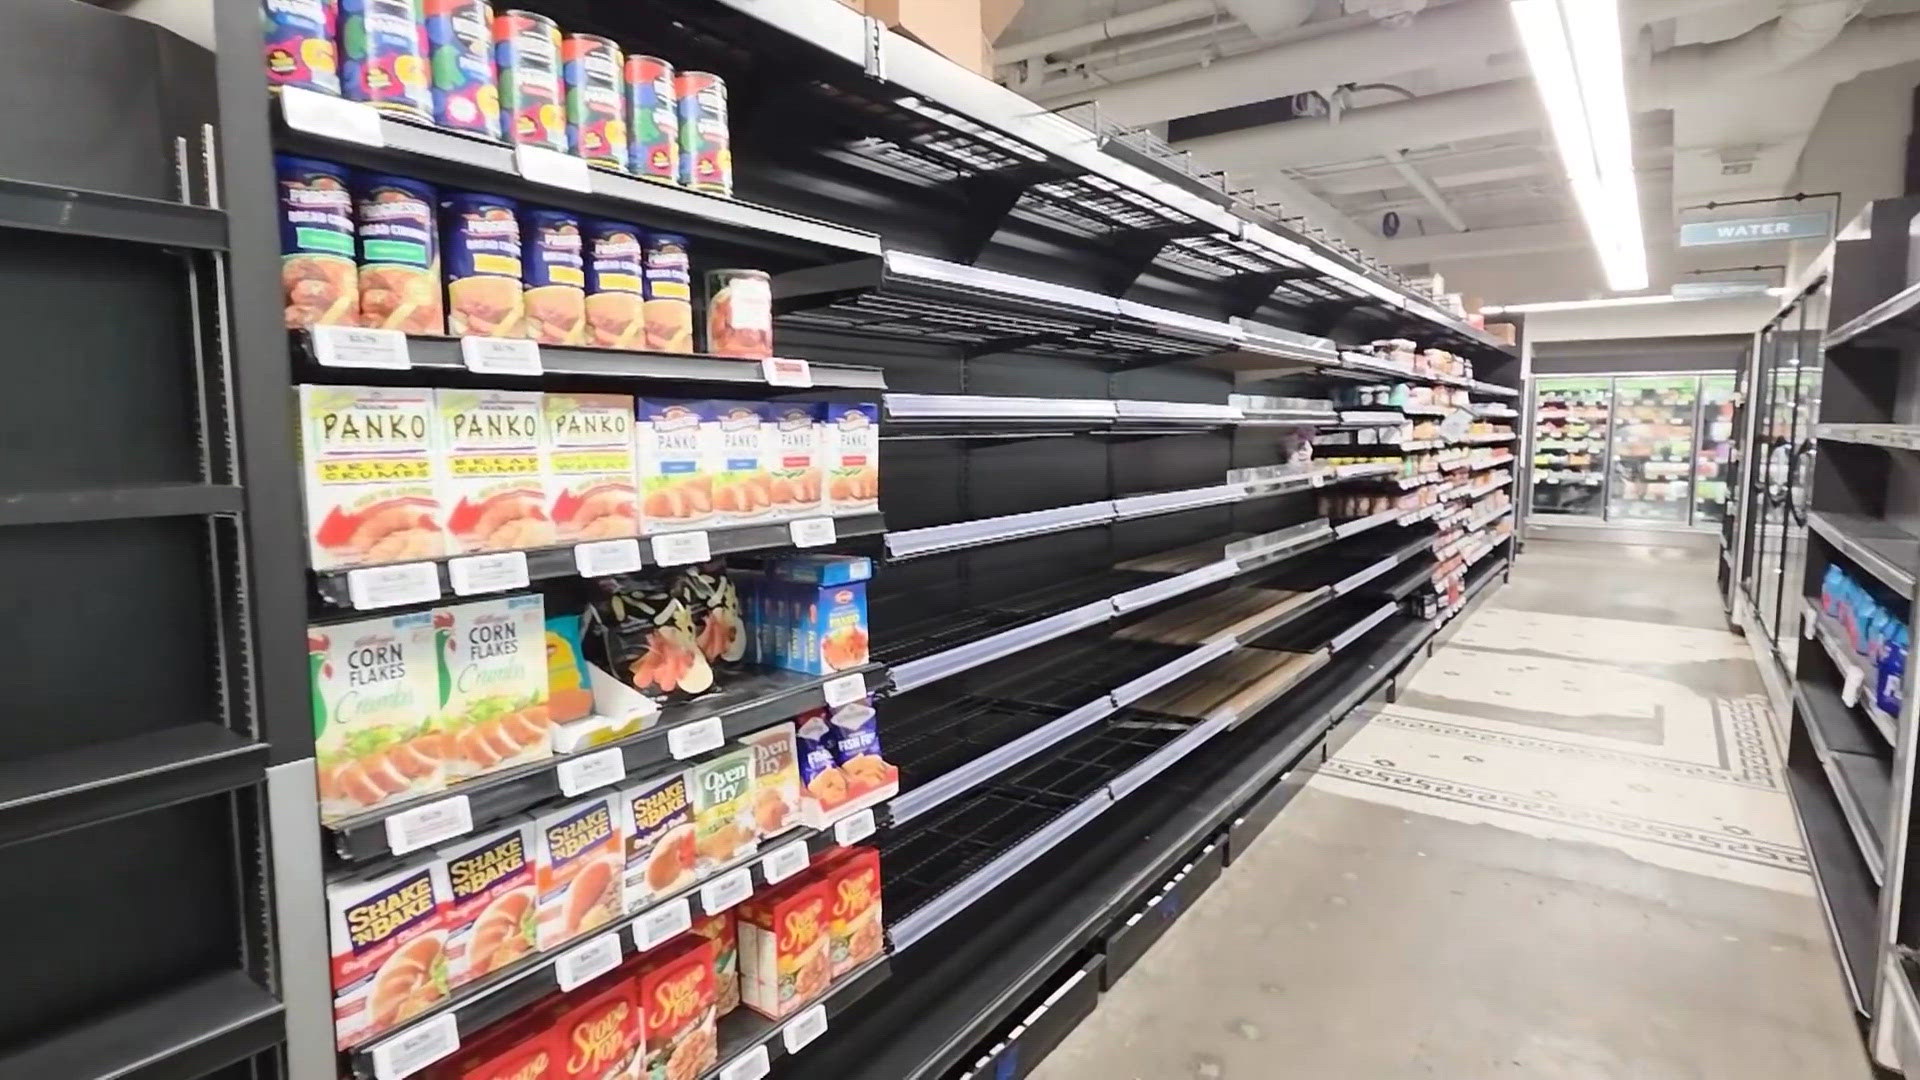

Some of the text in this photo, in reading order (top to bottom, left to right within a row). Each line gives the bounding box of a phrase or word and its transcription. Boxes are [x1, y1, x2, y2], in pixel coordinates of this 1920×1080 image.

[1717, 222, 1790, 238] WATER
[324, 413, 426, 439] PANKO
[454, 413, 536, 438] PANKO
[556, 414, 625, 433] PANKO
[658, 435, 697, 450] PANKO
[725, 434, 758, 447] PANKO
[782, 433, 811, 447] PANKO
[841, 433, 867, 447] PANKO
[469, 622, 516, 645] CORN
[348, 643, 403, 670] CORN
[470, 640, 518, 661] FLAKES
[350, 662, 405, 688] FLAKES
[704, 763, 746, 791] Oven
[634, 780, 684, 820] SHAKE
[648, 795, 687, 828] BAKE
[549, 807, 607, 848] SHAKE
[565, 822, 611, 858] BAKE
[450, 837, 521, 885] SHAKE
[470, 853, 525, 895] BAKE
[348, 876, 431, 933] SHAKE
[371, 895, 434, 942] BAKE
[650, 963, 706, 1029] Stove
[566, 1000, 629, 1074] Stove
[592, 1029, 624, 1074] Top
